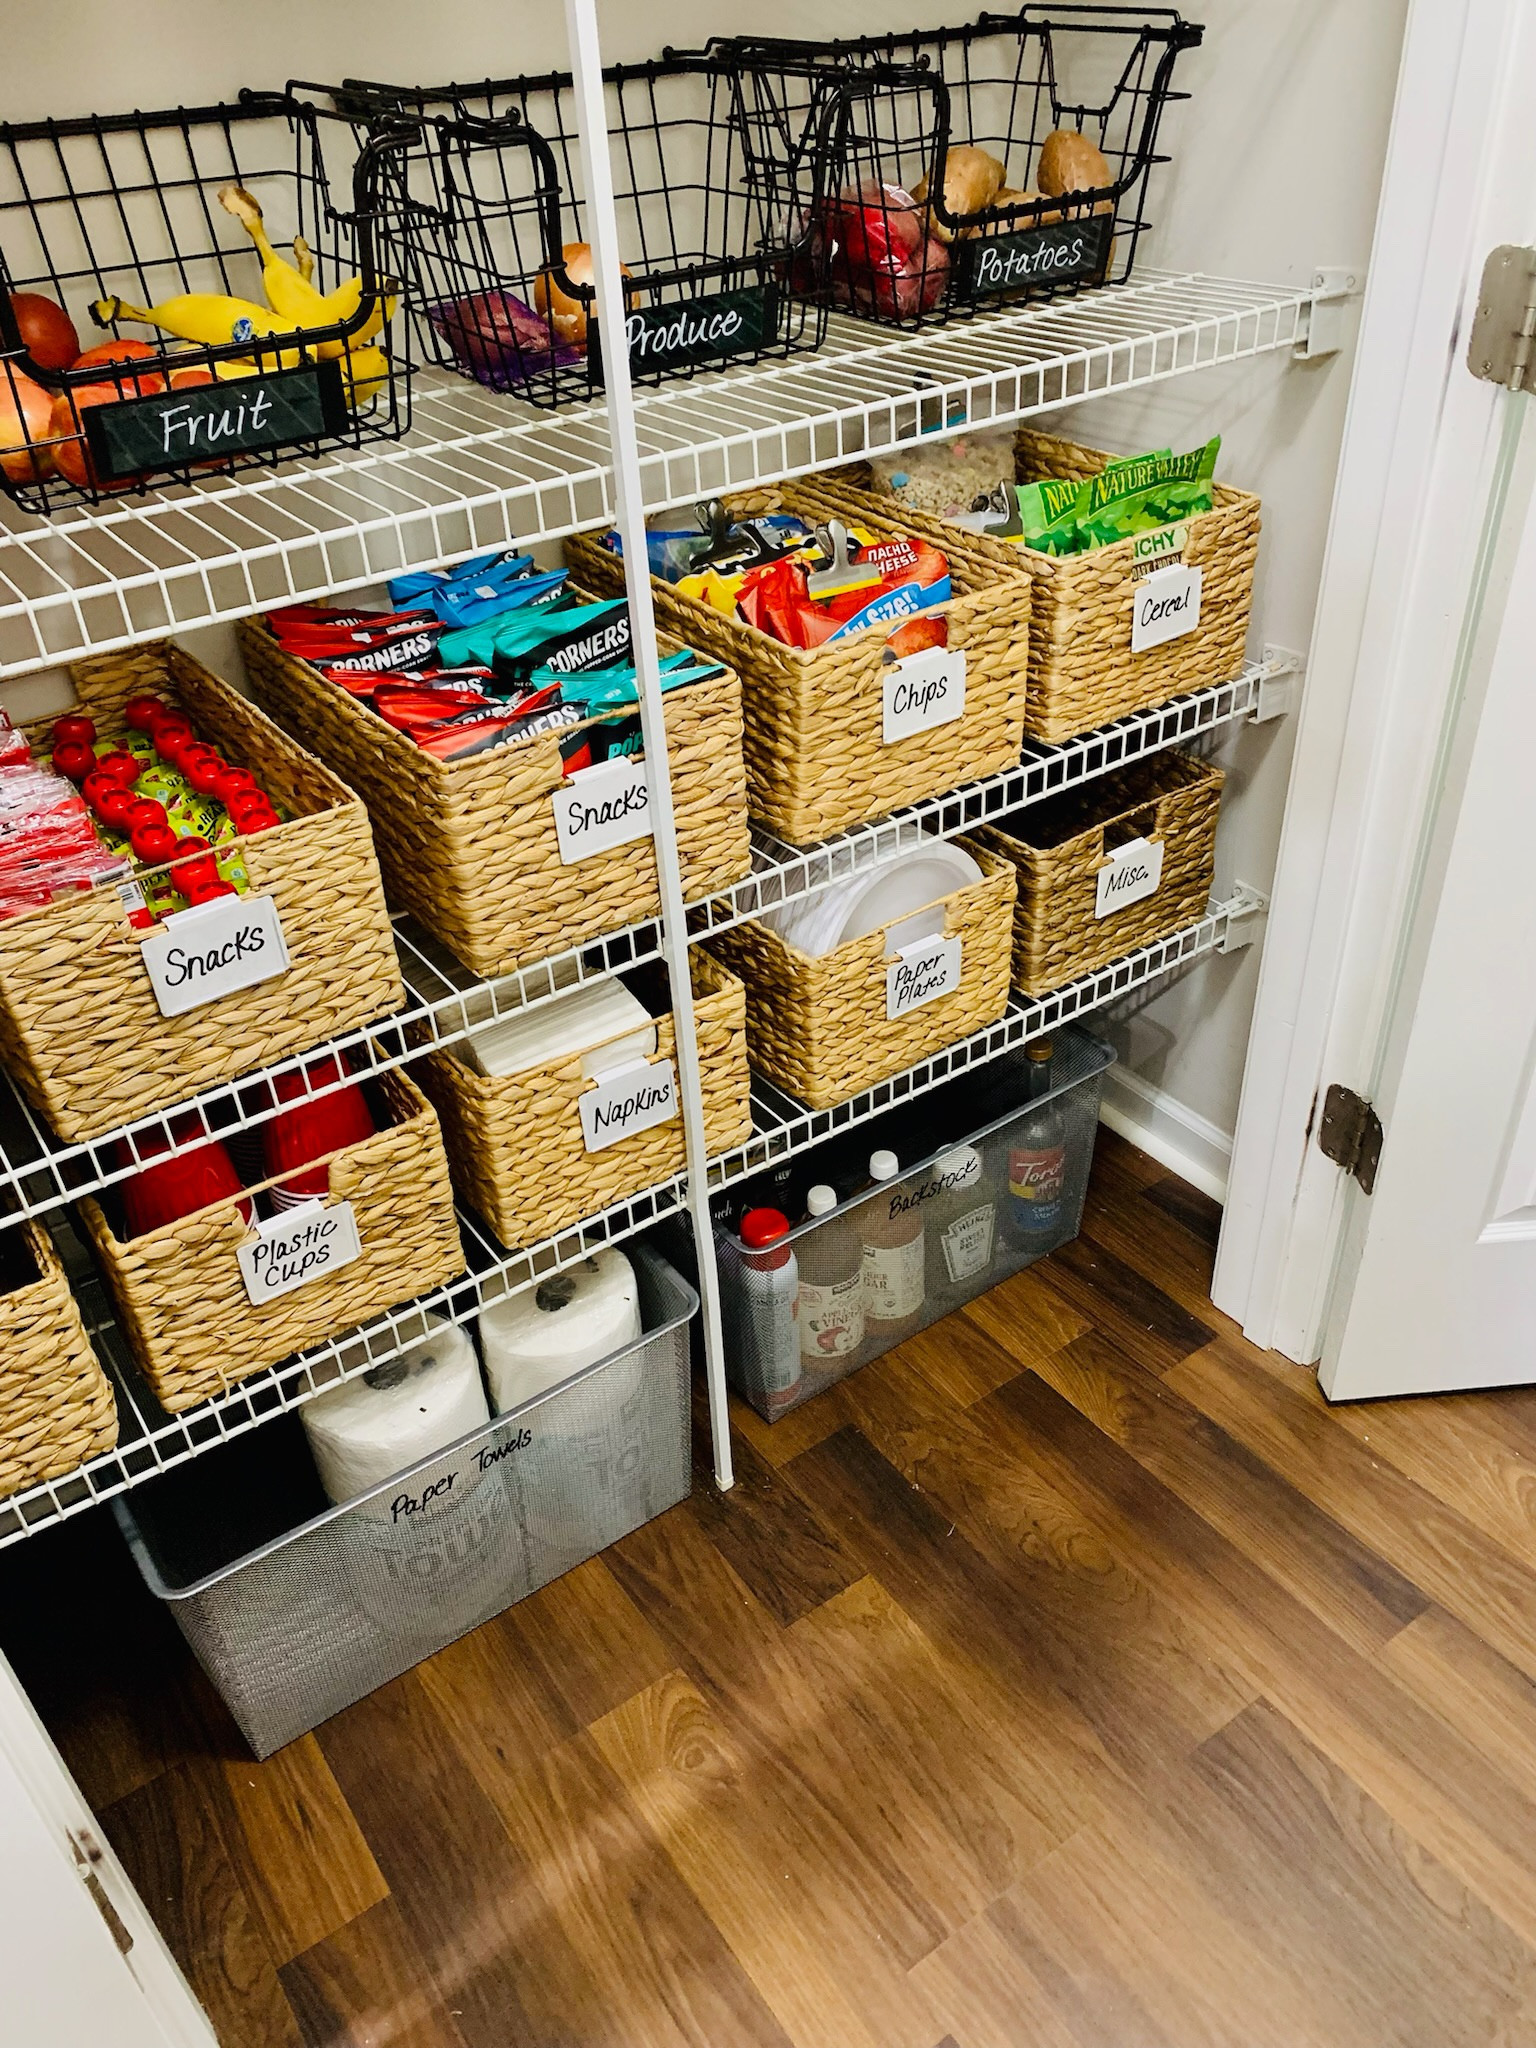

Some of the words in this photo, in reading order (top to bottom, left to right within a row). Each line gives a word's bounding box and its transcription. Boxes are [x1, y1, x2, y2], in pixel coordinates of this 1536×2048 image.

[976, 238, 1083, 287] Potatoes
[625, 310, 743, 357] Produce
[159, 389, 273, 453] Fruit
[1094, 463, 1154, 509] NATURE
[1156, 447, 1205, 483] VALLEY
[868, 542, 912, 562] NACHO
[876, 551, 918, 574] HEESE
[866, 590, 919, 625] Size!
[1141, 586, 1191, 628] Cereal
[546, 617, 630, 673] CORNERS
[893, 675, 948, 715] Chips
[568, 784, 649, 836] Snacks
[1104, 864, 1149, 899] Misc.
[165, 926, 265, 987] Snacks
[895, 953, 945, 991] Paper
[896, 970, 947, 1009] Plates
[594, 1083, 670, 1134] Napkins
[888, 1156, 979, 1220] Backstock
[252, 1219, 338, 1274] Plastic
[264, 1243, 330, 1287] Cups
[391, 1470, 459, 1523] Paper
[471, 1428, 532, 1473] Towels
